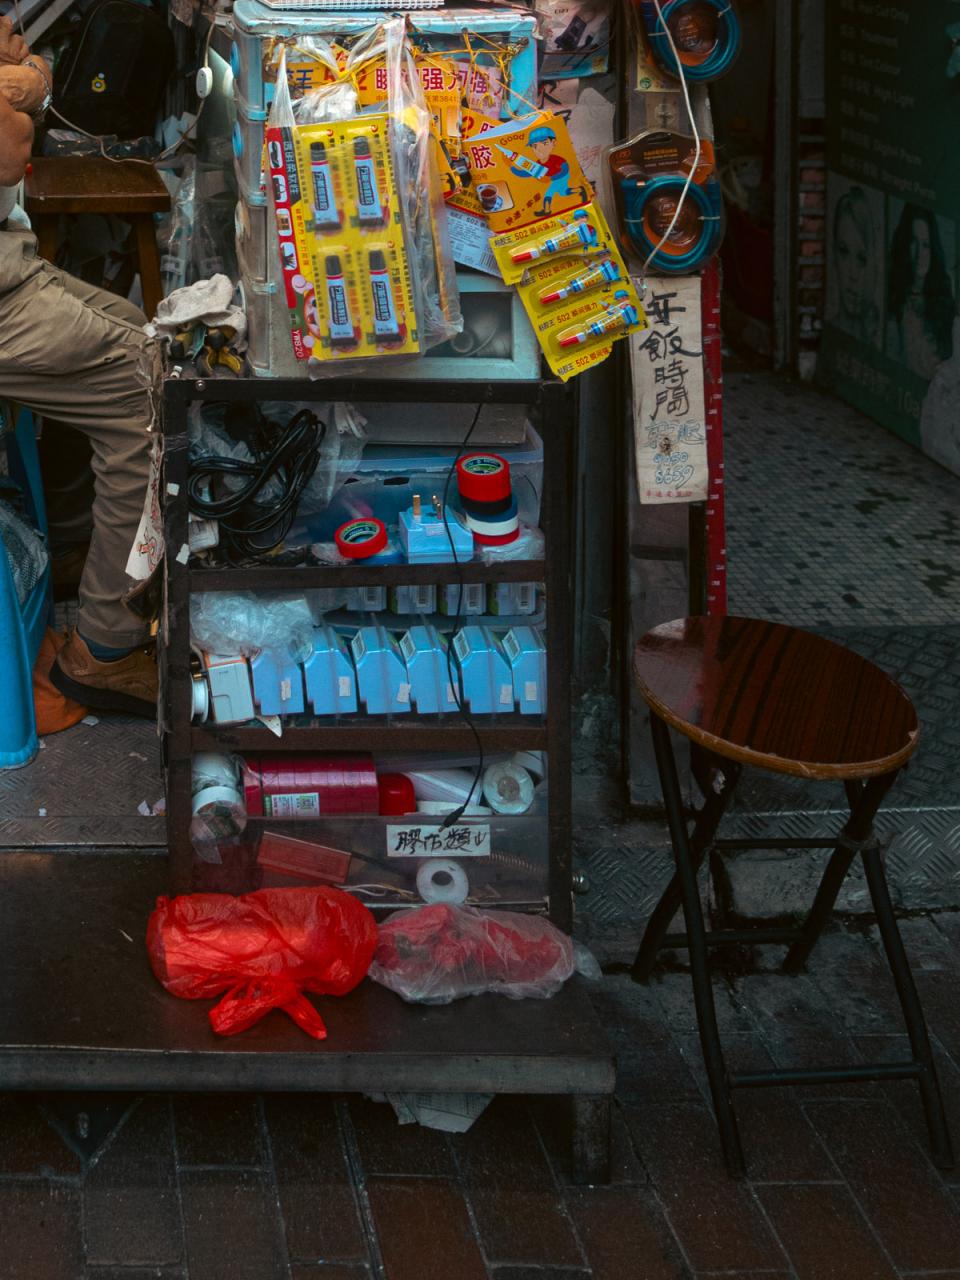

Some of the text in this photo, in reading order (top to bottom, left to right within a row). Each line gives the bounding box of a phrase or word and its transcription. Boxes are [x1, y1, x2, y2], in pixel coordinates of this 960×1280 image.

[499, 133, 526, 146] Good
[514, 230, 529, 241] 502
[538, 269, 553, 280] 502
[556, 313, 571, 325] 502
[575, 356, 590, 368] 502
